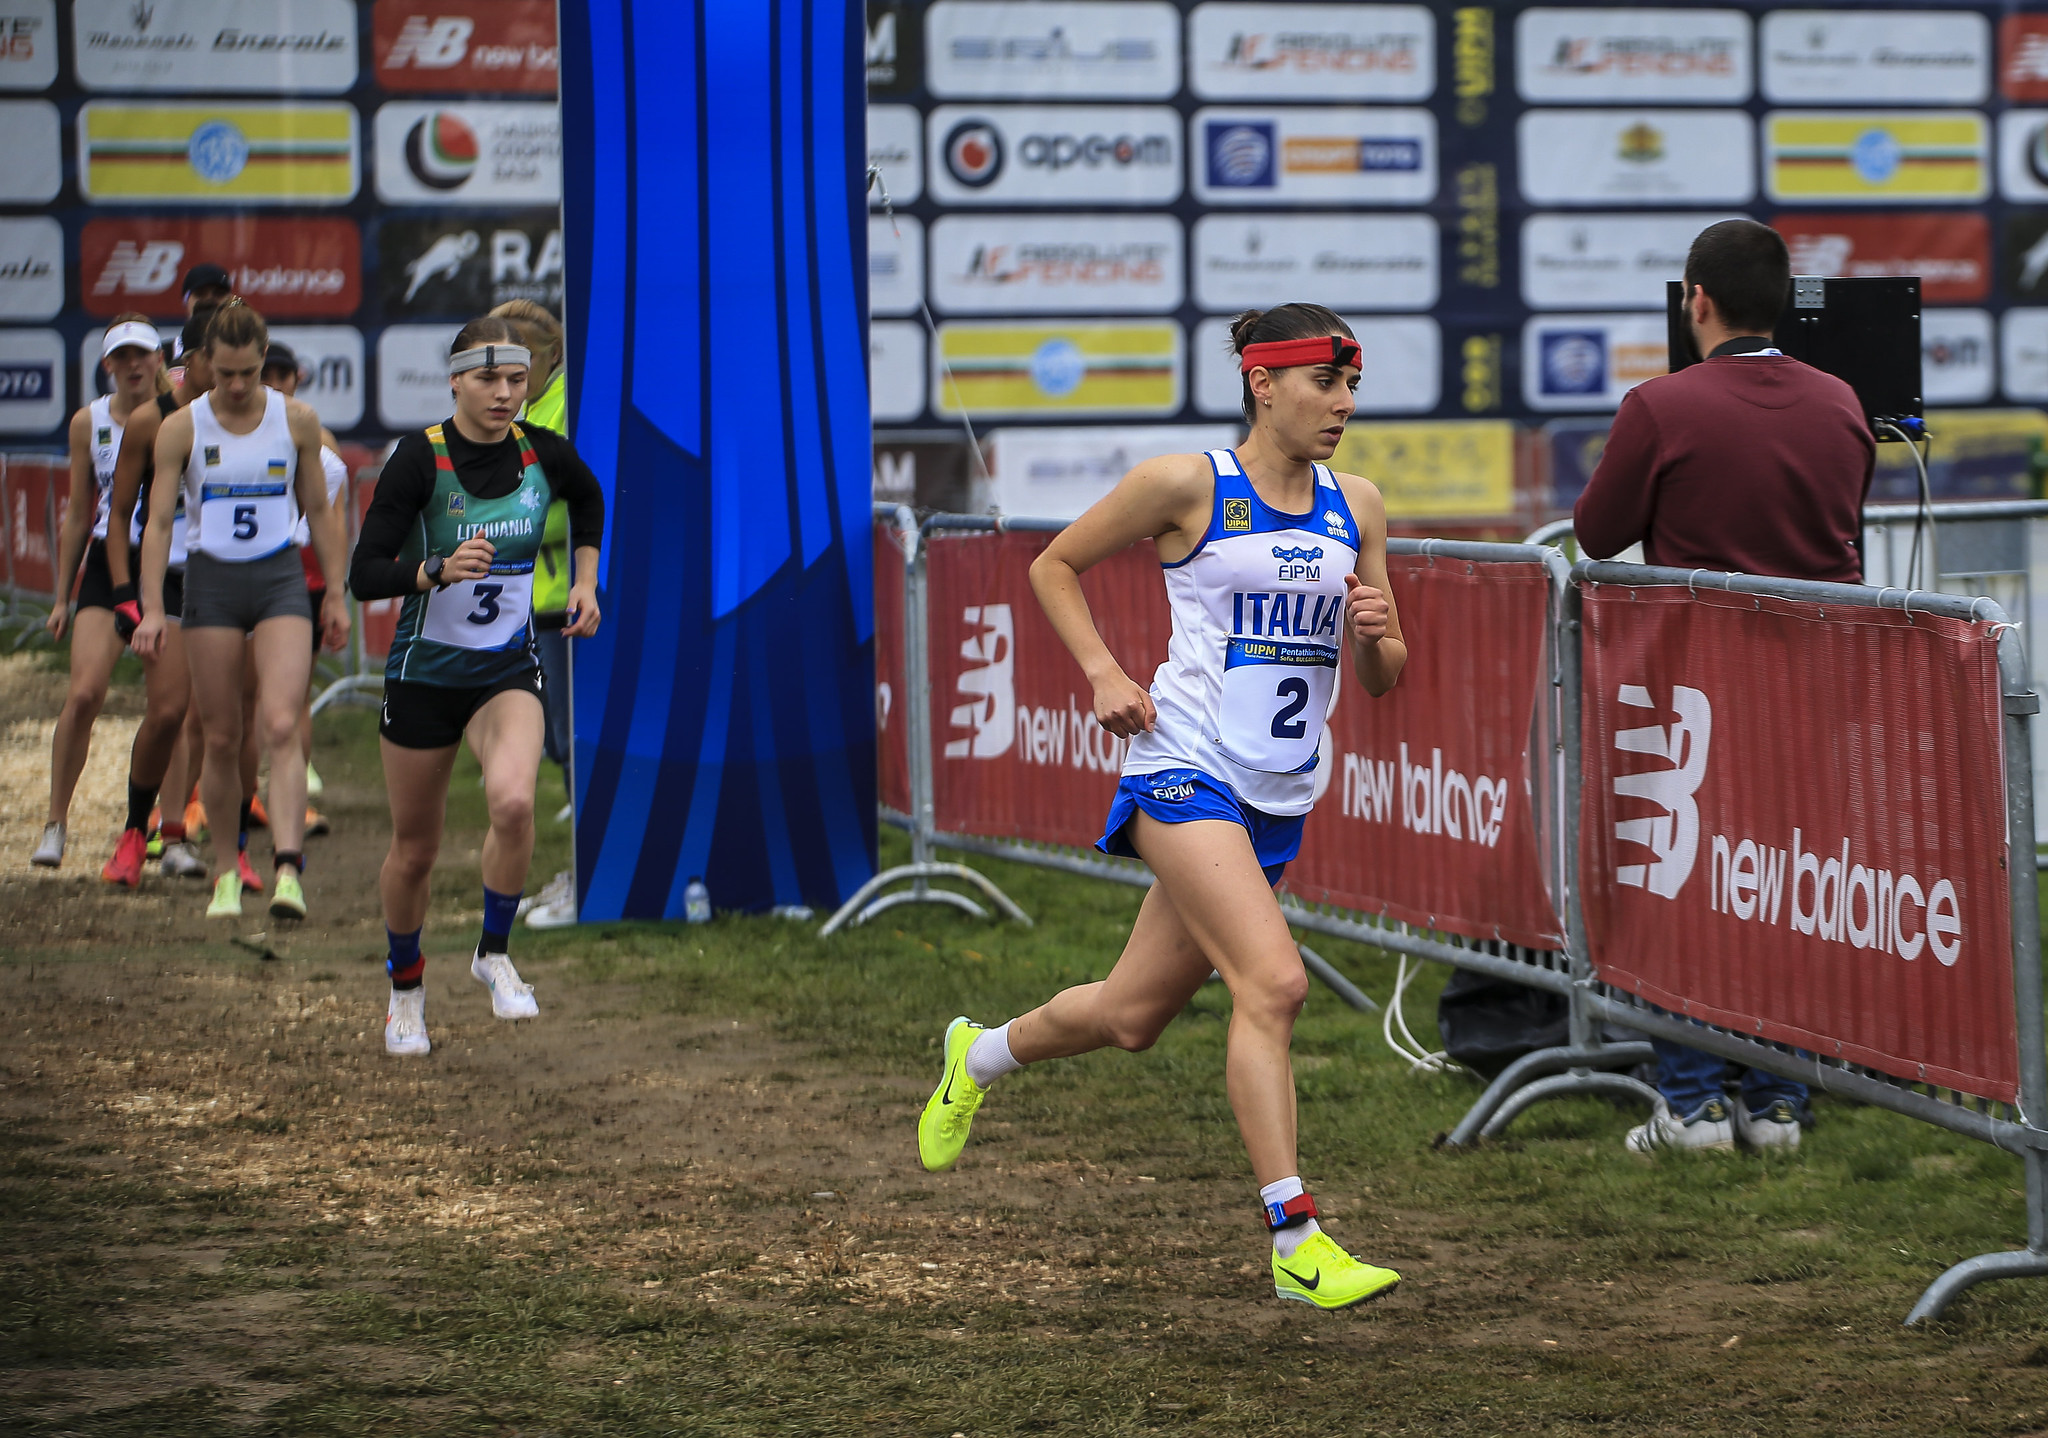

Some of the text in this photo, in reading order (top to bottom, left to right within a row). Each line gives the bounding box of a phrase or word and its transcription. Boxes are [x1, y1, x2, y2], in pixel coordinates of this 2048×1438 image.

[239, 265, 345, 295] balance
[233, 503, 258, 539] 5
[457, 517, 533, 541] LITHUANIA
[1278, 565, 1320, 578] FIPM
[467, 582, 505, 625] 3
[1233, 592, 1343, 636] ITALIA
[1244, 643, 1336, 659] UIPM Pentathlon World
[1270, 676, 1310, 739] 2
[1017, 705, 1067, 765] new
[1153, 782, 1195, 799] FIPM
[1342, 741, 1508, 848] new balance
[1711, 827, 1962, 967] new balance
